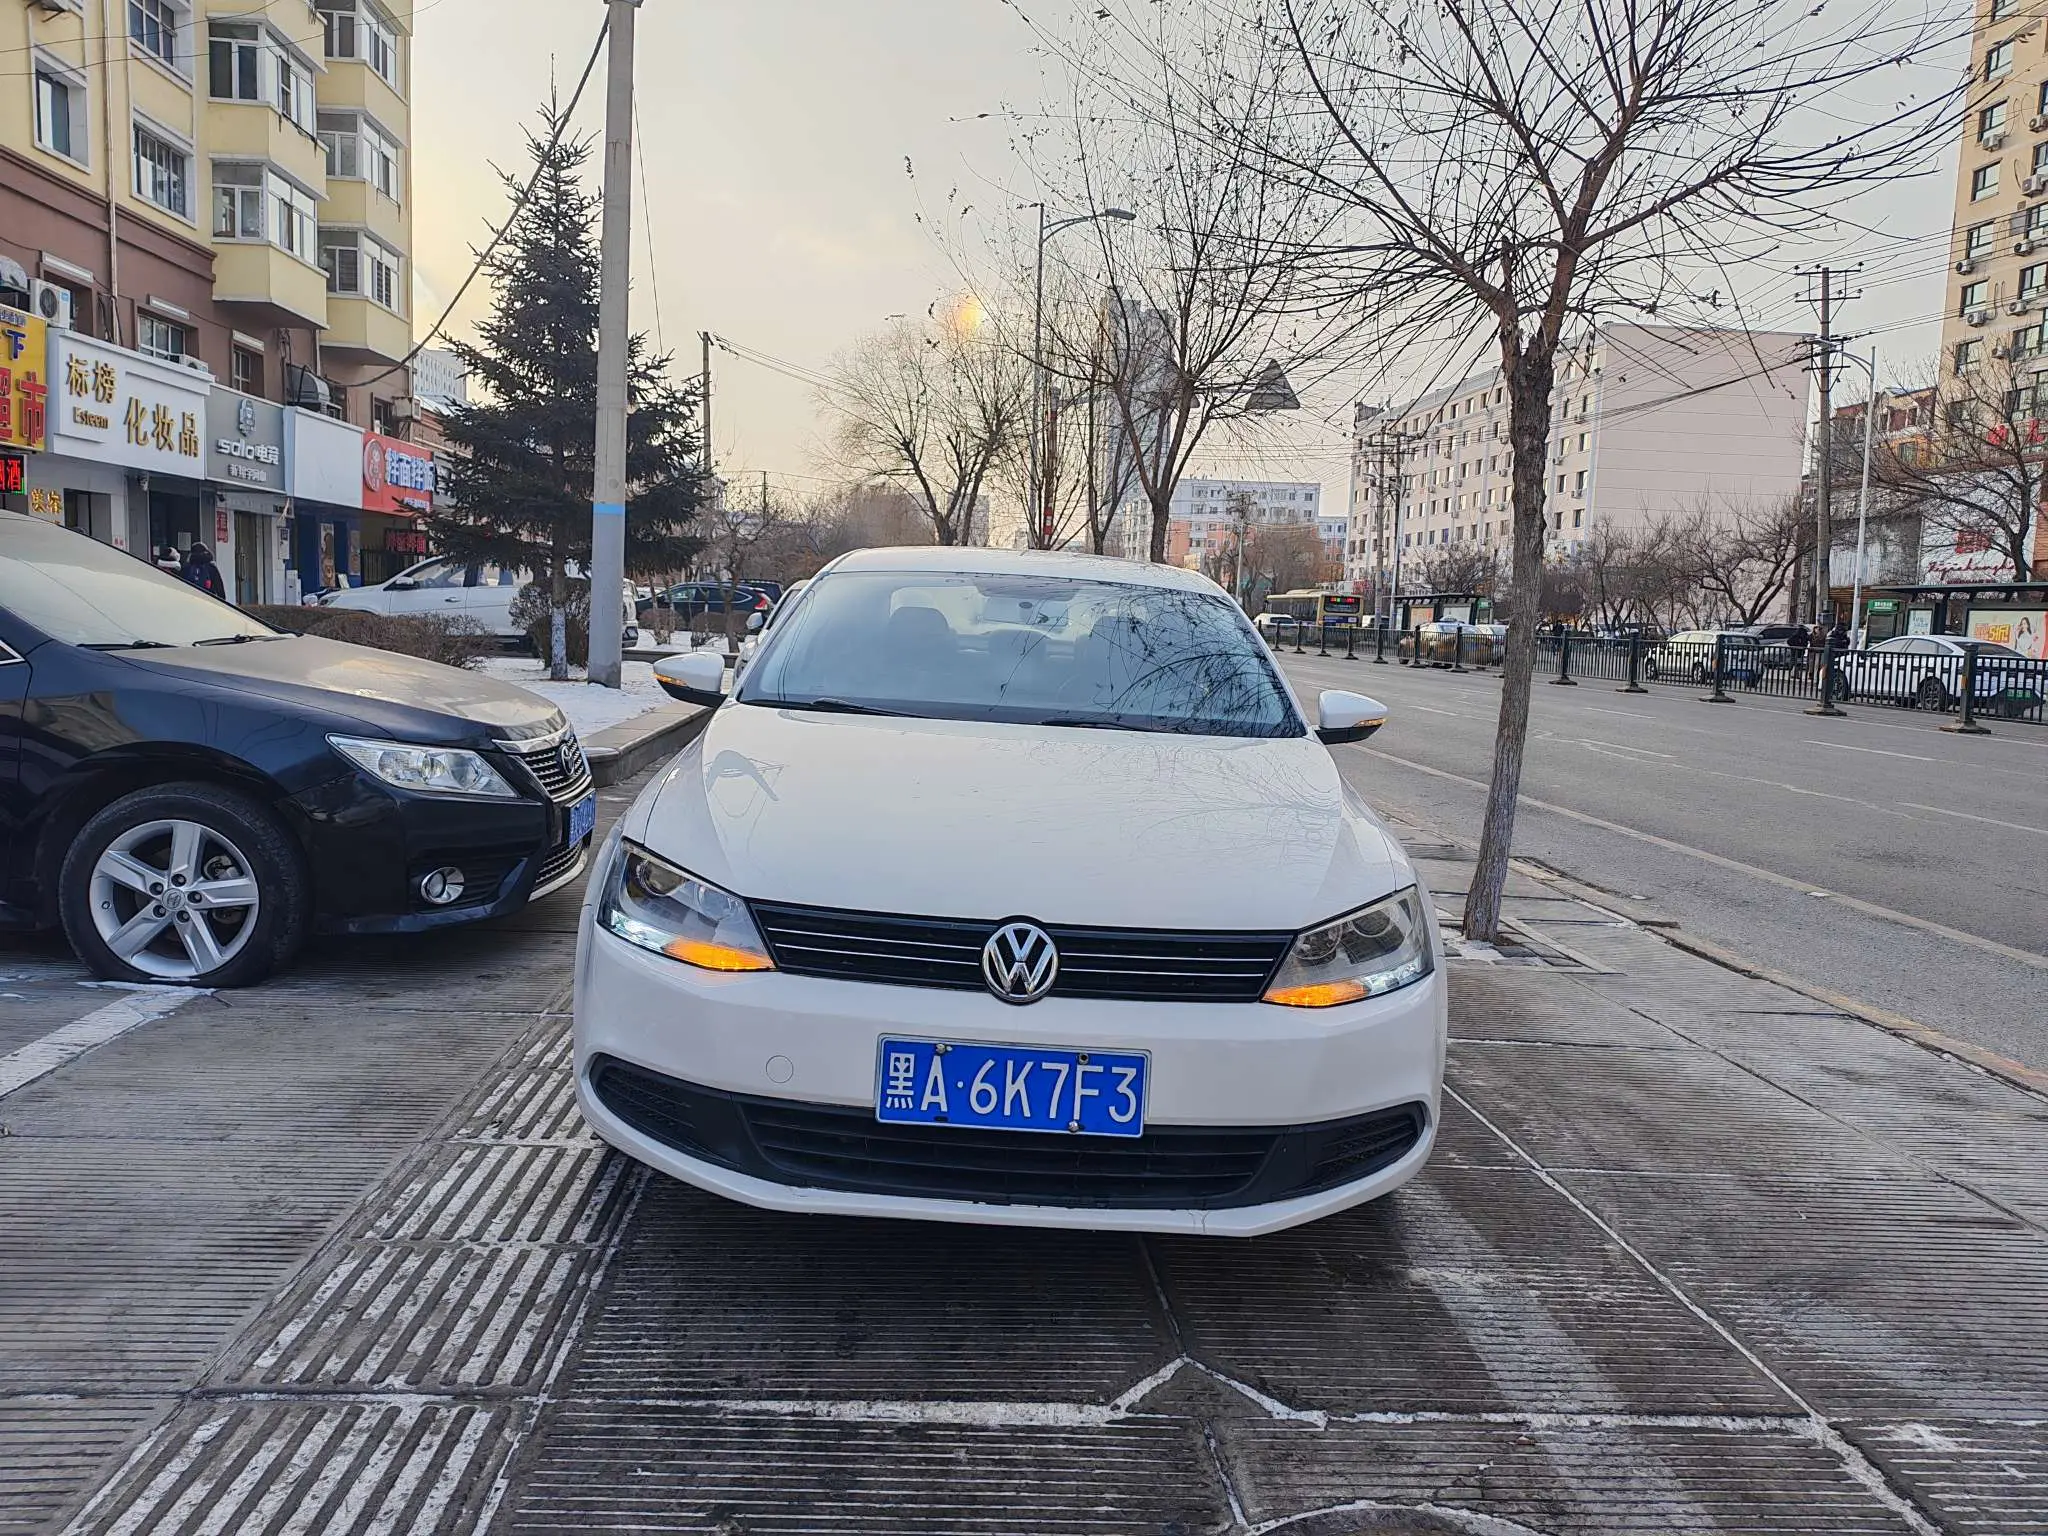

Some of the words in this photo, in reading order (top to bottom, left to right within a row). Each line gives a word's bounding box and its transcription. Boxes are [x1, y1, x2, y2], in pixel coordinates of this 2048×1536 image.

[66, 353, 117, 404] 标榜
[73, 406, 109, 430] Esteem
[124, 397, 200, 458] 化妆品
[885, 1052, 1137, 1123] 黑A·6K7F3
